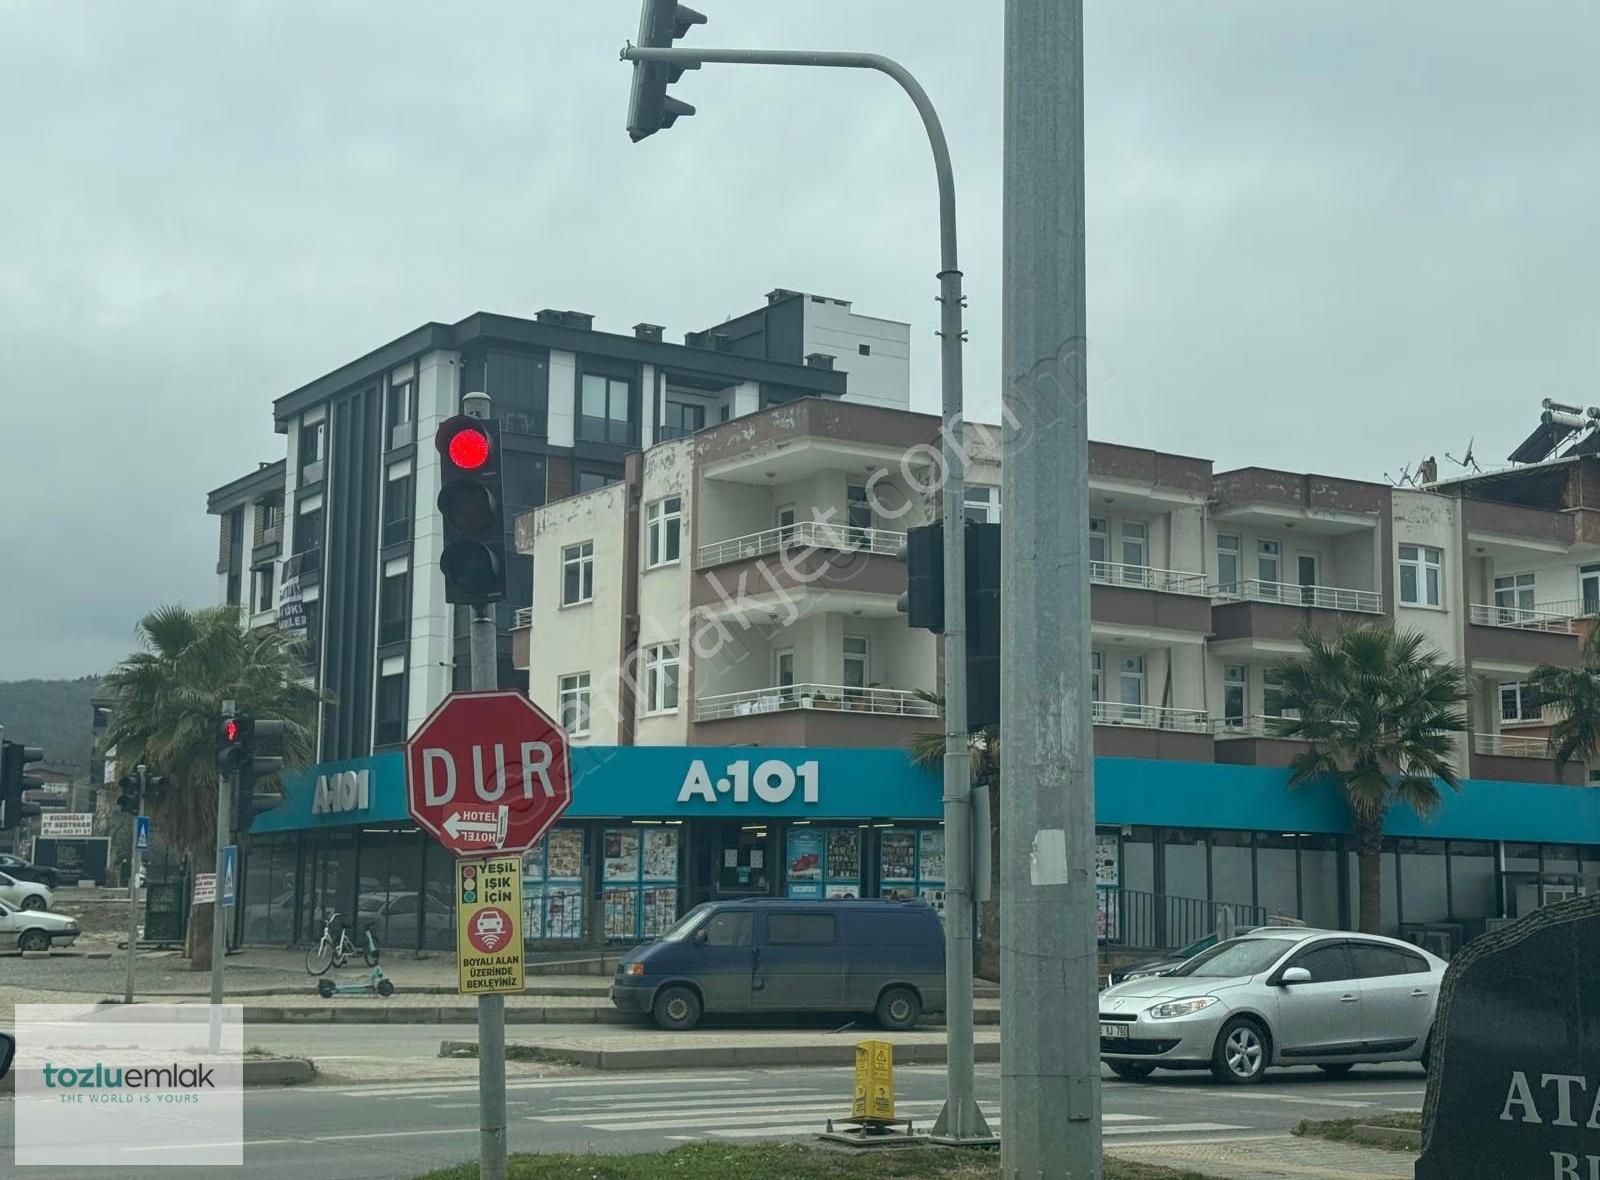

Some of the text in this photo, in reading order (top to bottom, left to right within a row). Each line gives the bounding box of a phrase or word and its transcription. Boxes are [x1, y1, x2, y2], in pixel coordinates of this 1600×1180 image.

[422, 741, 556, 807] DUR
[462, 811, 498, 822] HOTEL
[461, 831, 496, 842] HOTEL
[479, 862, 517, 876] YEŞİL
[484, 876, 511, 889] IŞIK
[484, 890, 512, 904] İÇİN
[463, 956, 519, 967] BOYALI ALAN
[470, 966, 513, 977] ÜZERİNDE
[466, 977, 517, 989] BEKLEYİNİZ
